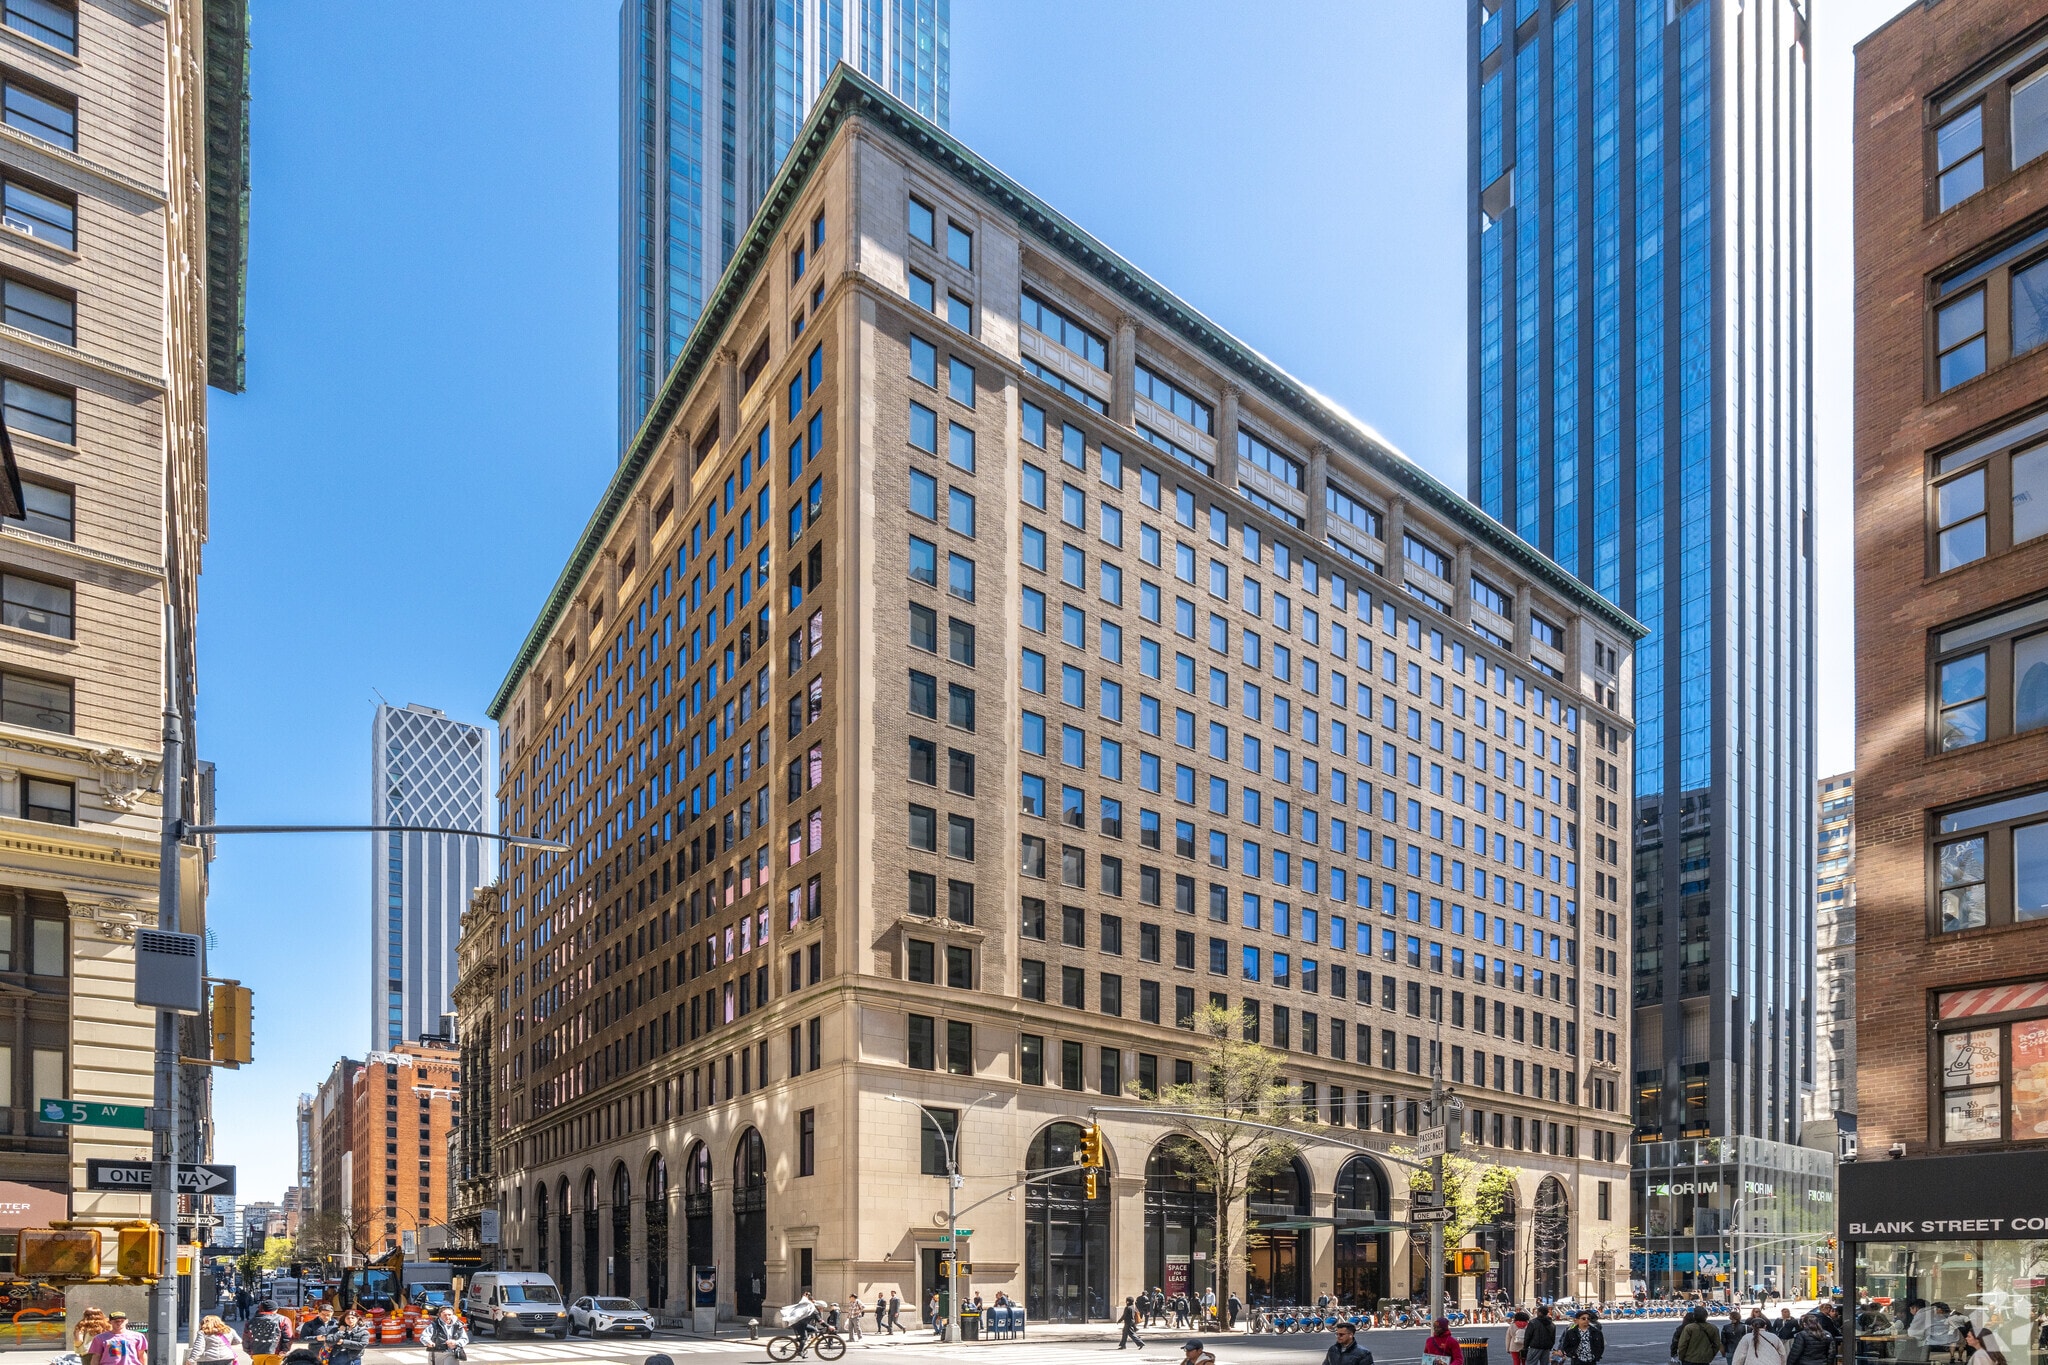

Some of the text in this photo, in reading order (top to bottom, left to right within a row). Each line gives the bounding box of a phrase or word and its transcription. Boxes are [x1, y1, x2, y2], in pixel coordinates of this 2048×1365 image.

[71, 1104, 118, 1122] 5 AV
[1419, 1129, 1444, 1143] PASSENGER
[1420, 1140, 1444, 1154] CARS ONLY
[110, 1170, 152, 1183] ONE
[1849, 1217, 2048, 1235] BLANK STREET CO
